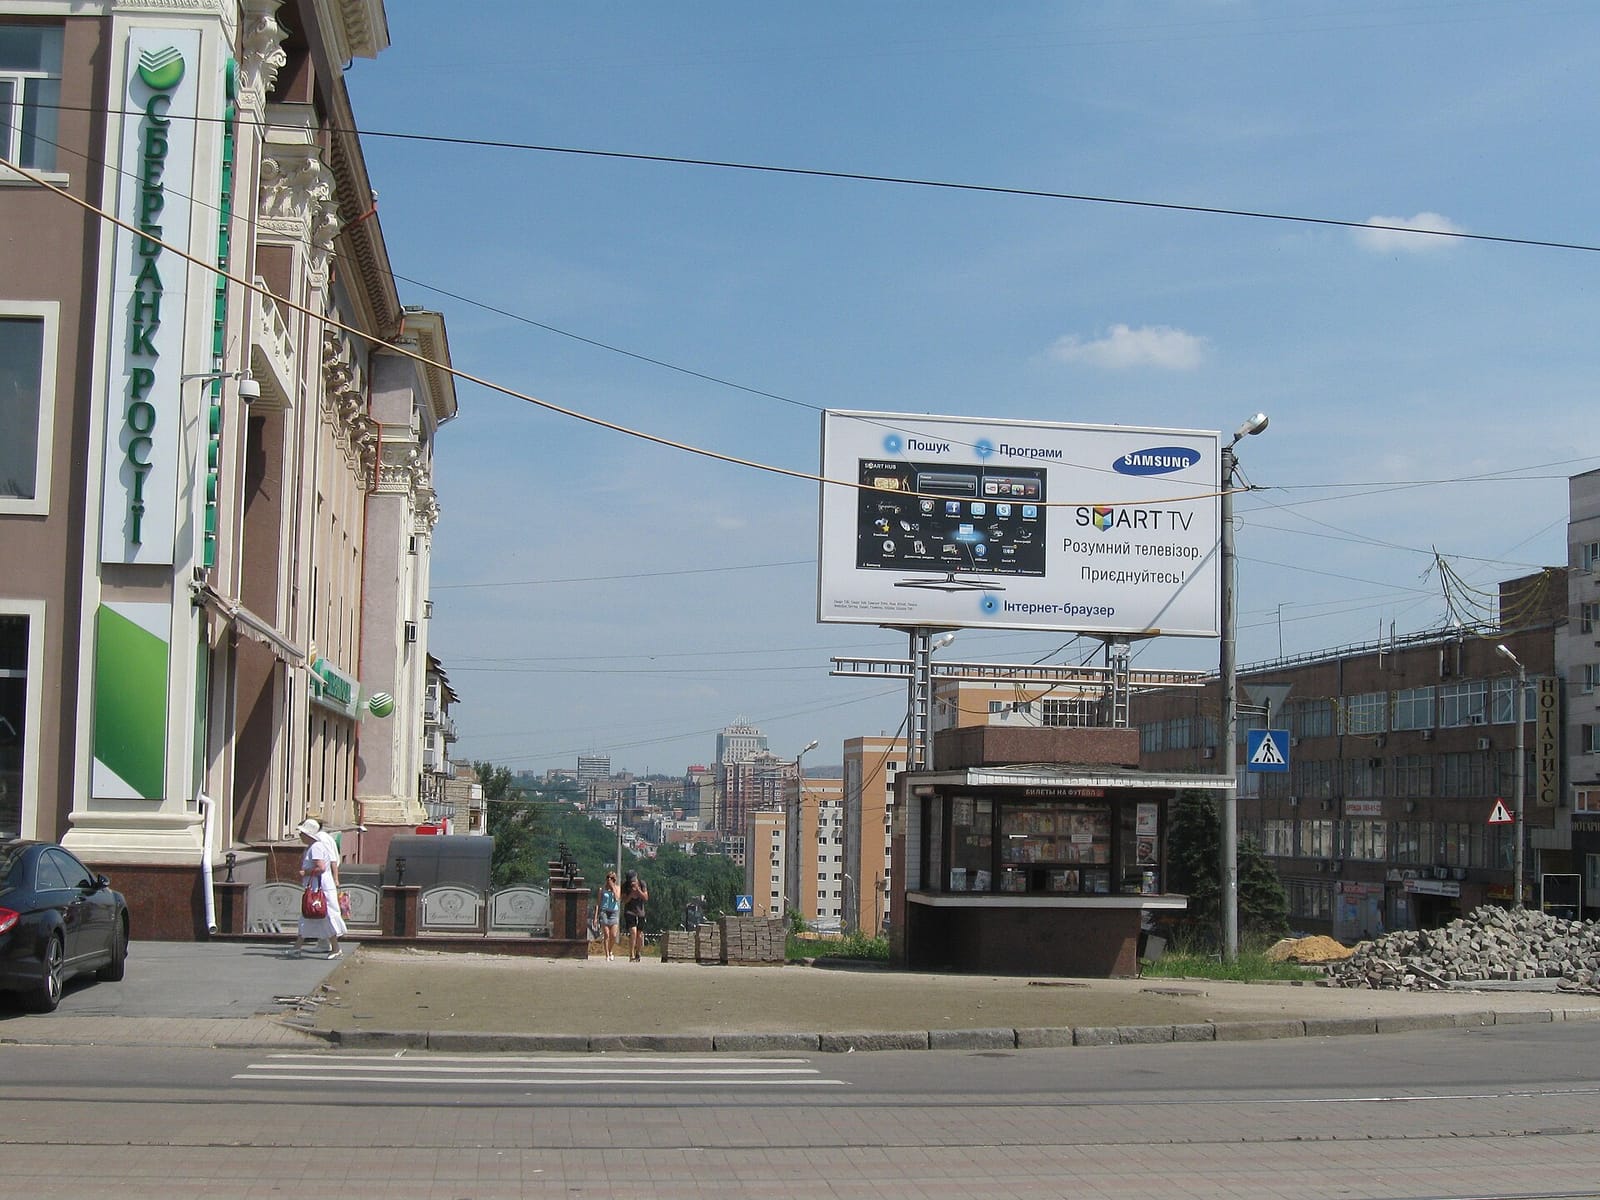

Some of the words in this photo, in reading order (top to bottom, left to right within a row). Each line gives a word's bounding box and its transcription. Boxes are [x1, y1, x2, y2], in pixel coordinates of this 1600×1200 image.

[132, 95, 171, 357] СБЕРБАНК
[128, 366, 155, 546] РОСІЇ
[907, 439, 951, 453] Пошук
[999, 443, 1062, 460] Програми
[1123, 454, 1191, 469] SAMSUNG
[1166, 511, 1194, 532] TV
[1063, 538, 1131, 556] Розумний
[1134, 542, 1203, 560] телевізор.
[1080, 566, 1186, 585] Приєднуйтесь!
[1004, 600, 1115, 617] Інтернет-браузер
[1541, 679, 1556, 803] НОТАРИУС
